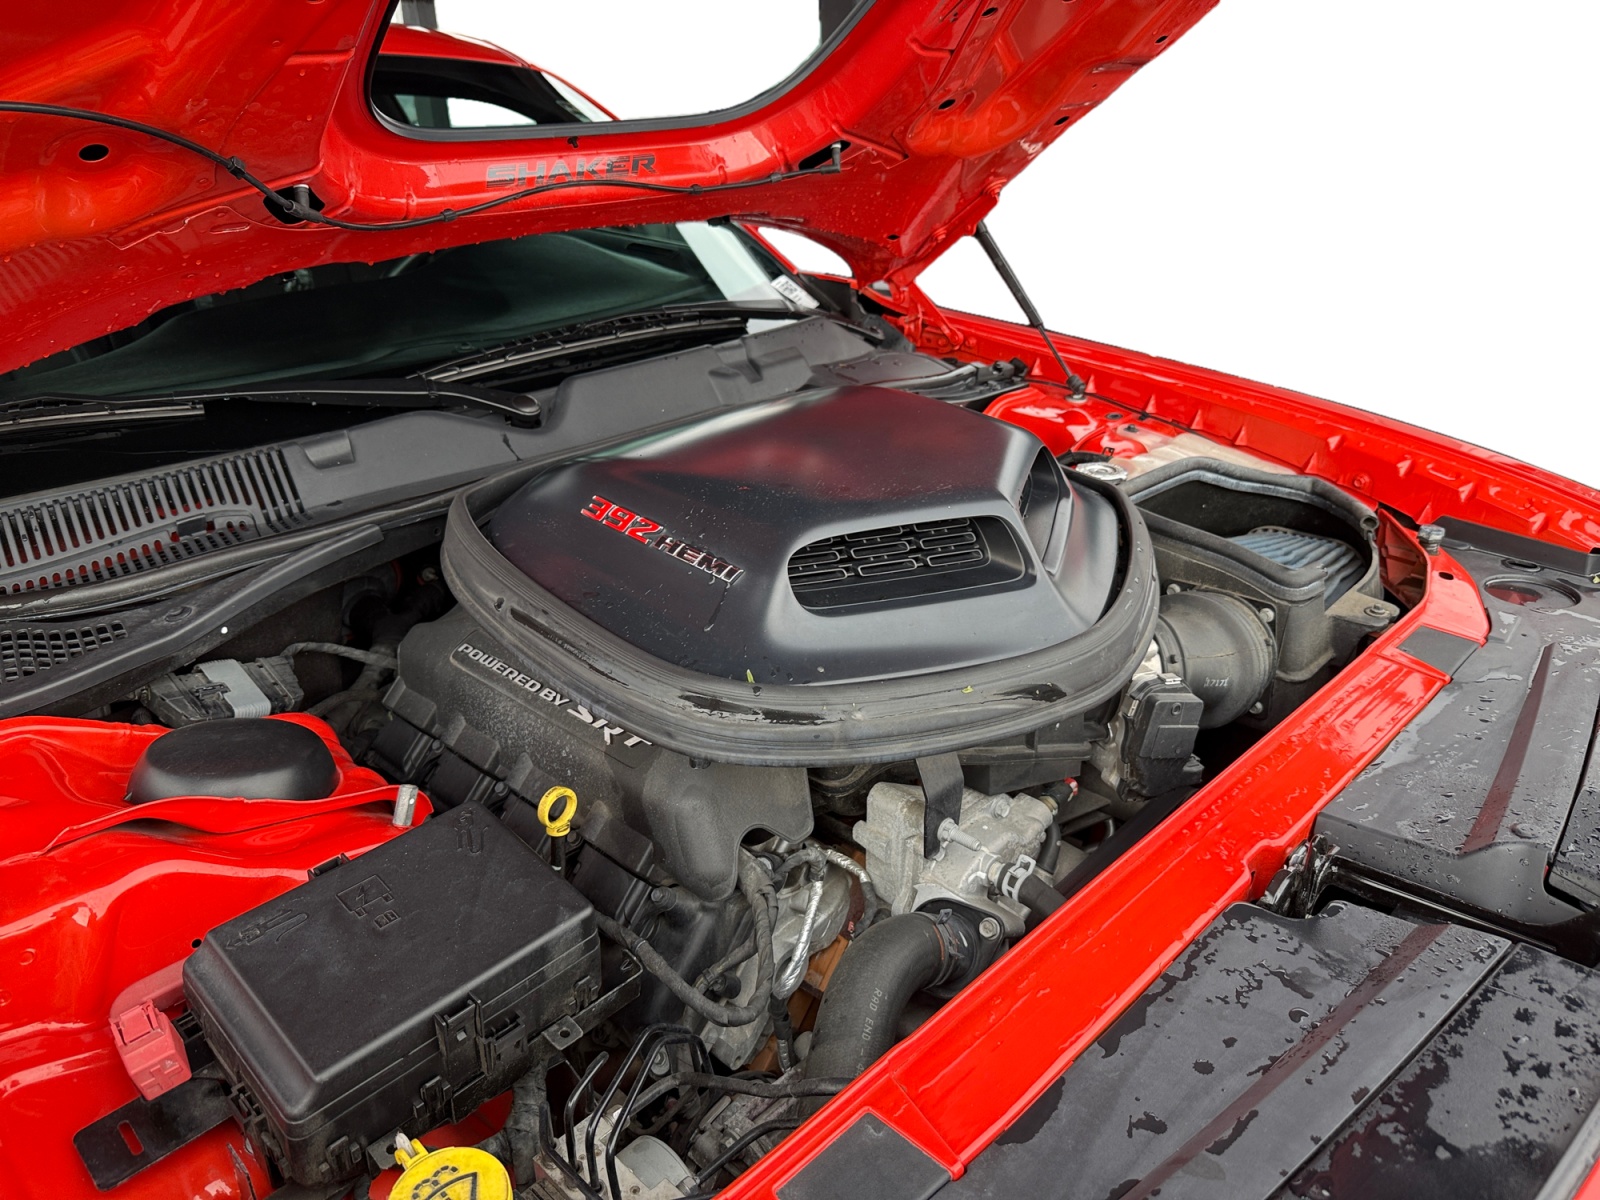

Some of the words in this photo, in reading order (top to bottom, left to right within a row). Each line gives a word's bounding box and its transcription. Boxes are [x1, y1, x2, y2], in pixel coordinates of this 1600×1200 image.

[486, 153, 658, 188] SHAKER
[581, 495, 664, 545] 392
[653, 534, 745, 584] HEMI
[458, 643, 541, 692] POWERED
[539, 688, 570, 707] BY
[567, 705, 653, 748] SRT
[869, 987, 883, 1012] RAD
[861, 1017, 874, 1041] END
